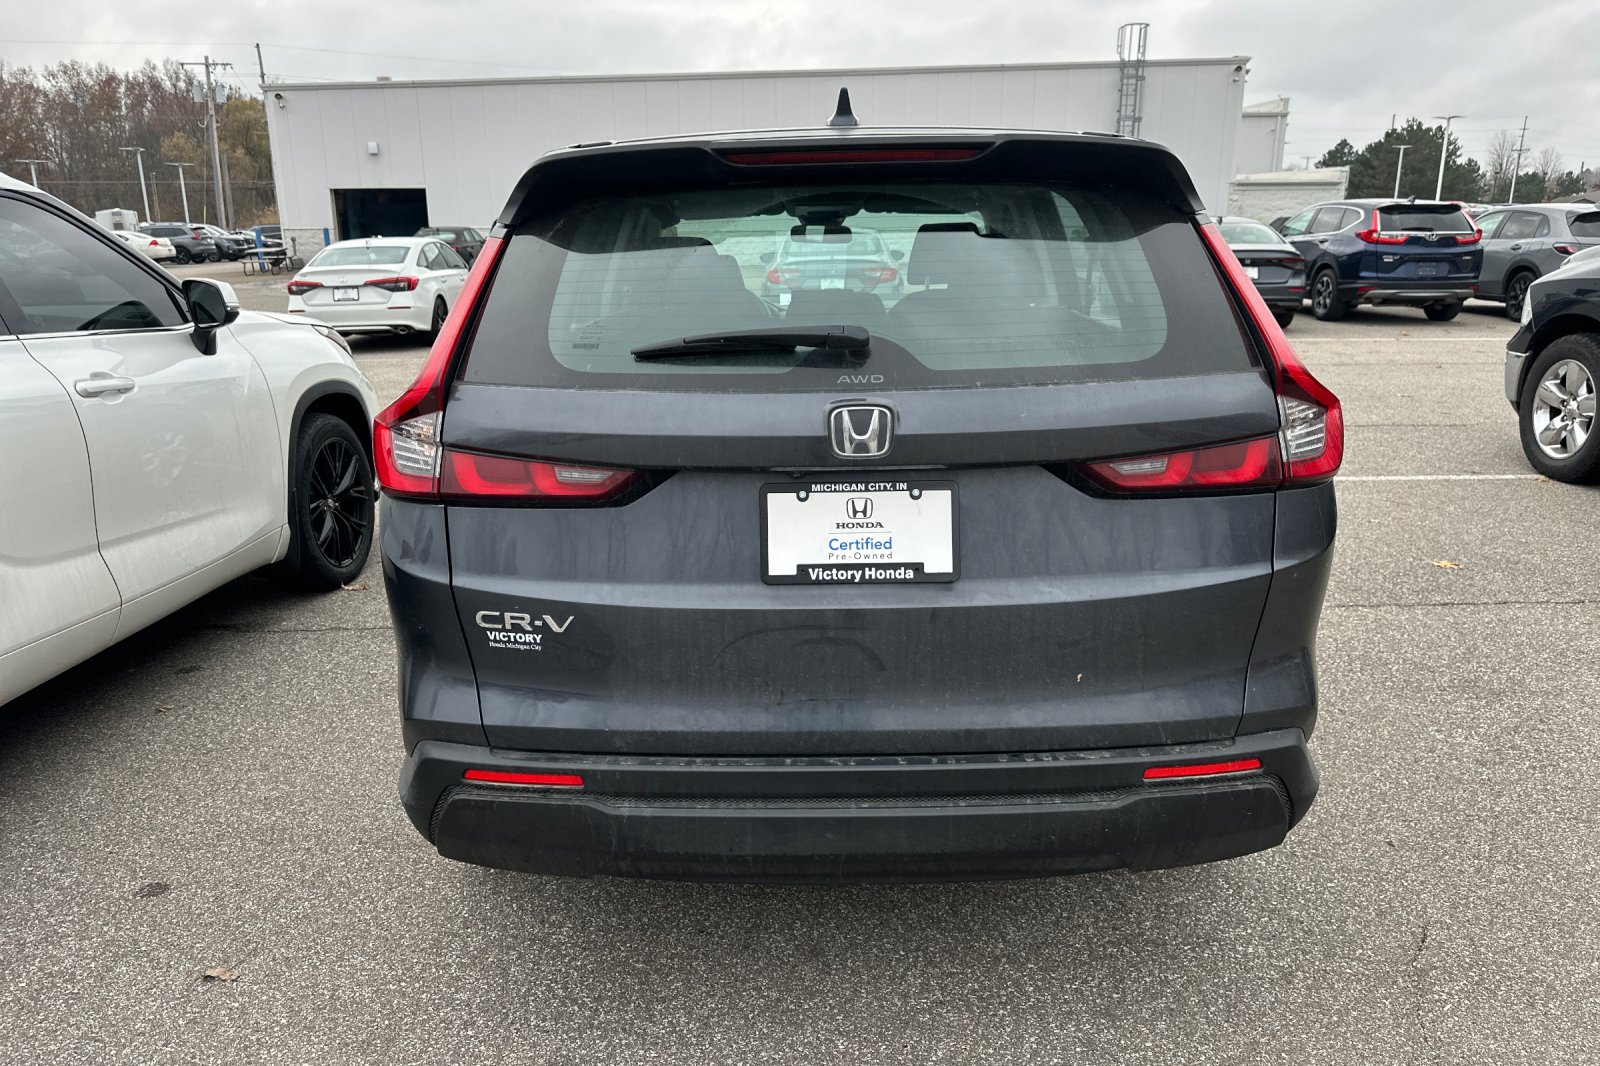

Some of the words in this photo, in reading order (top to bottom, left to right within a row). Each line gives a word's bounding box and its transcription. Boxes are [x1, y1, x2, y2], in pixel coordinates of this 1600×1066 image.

[837, 374, 884, 384] AWD
[811, 483, 865, 492] MICHIGAN
[868, 483, 893, 492] CITY,
[896, 482, 907, 491] IN
[828, 537, 892, 551] Certified
[828, 551, 893, 560] Pre-Owned
[808, 568, 862, 582] Victory
[865, 567, 914, 579] Honda
[475, 610, 575, 633] CR-V
[486, 630, 542, 643] VICTORY
[506, 642, 530, 650] Michigan
